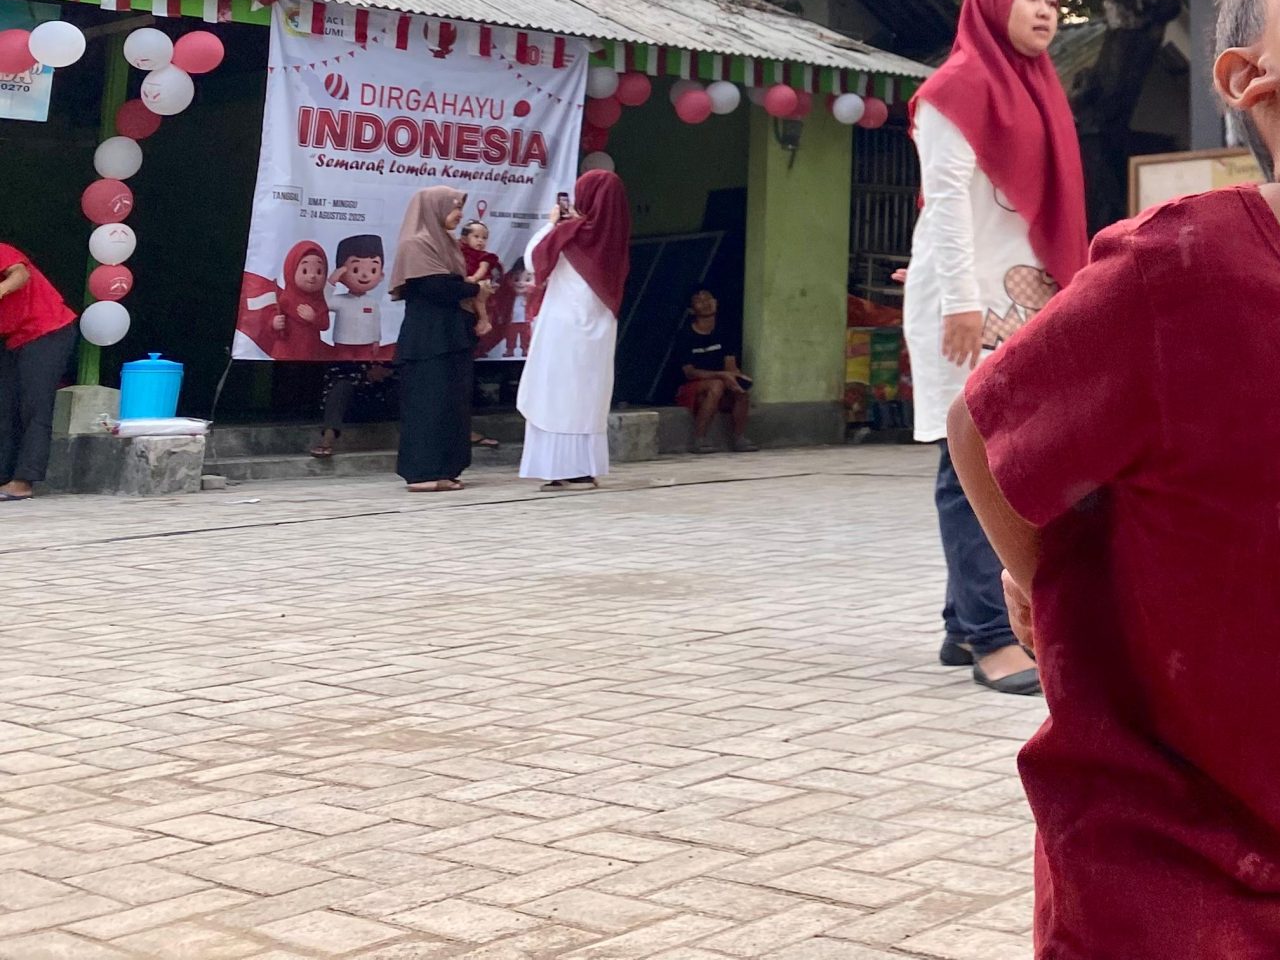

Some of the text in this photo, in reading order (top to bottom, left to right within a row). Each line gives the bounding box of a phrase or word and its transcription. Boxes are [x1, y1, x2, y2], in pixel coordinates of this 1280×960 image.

[361, 82, 505, 120] DIRGAHAYU
[297, 105, 548, 168] INDONESIA
[388, 160, 437, 177] Lomba
